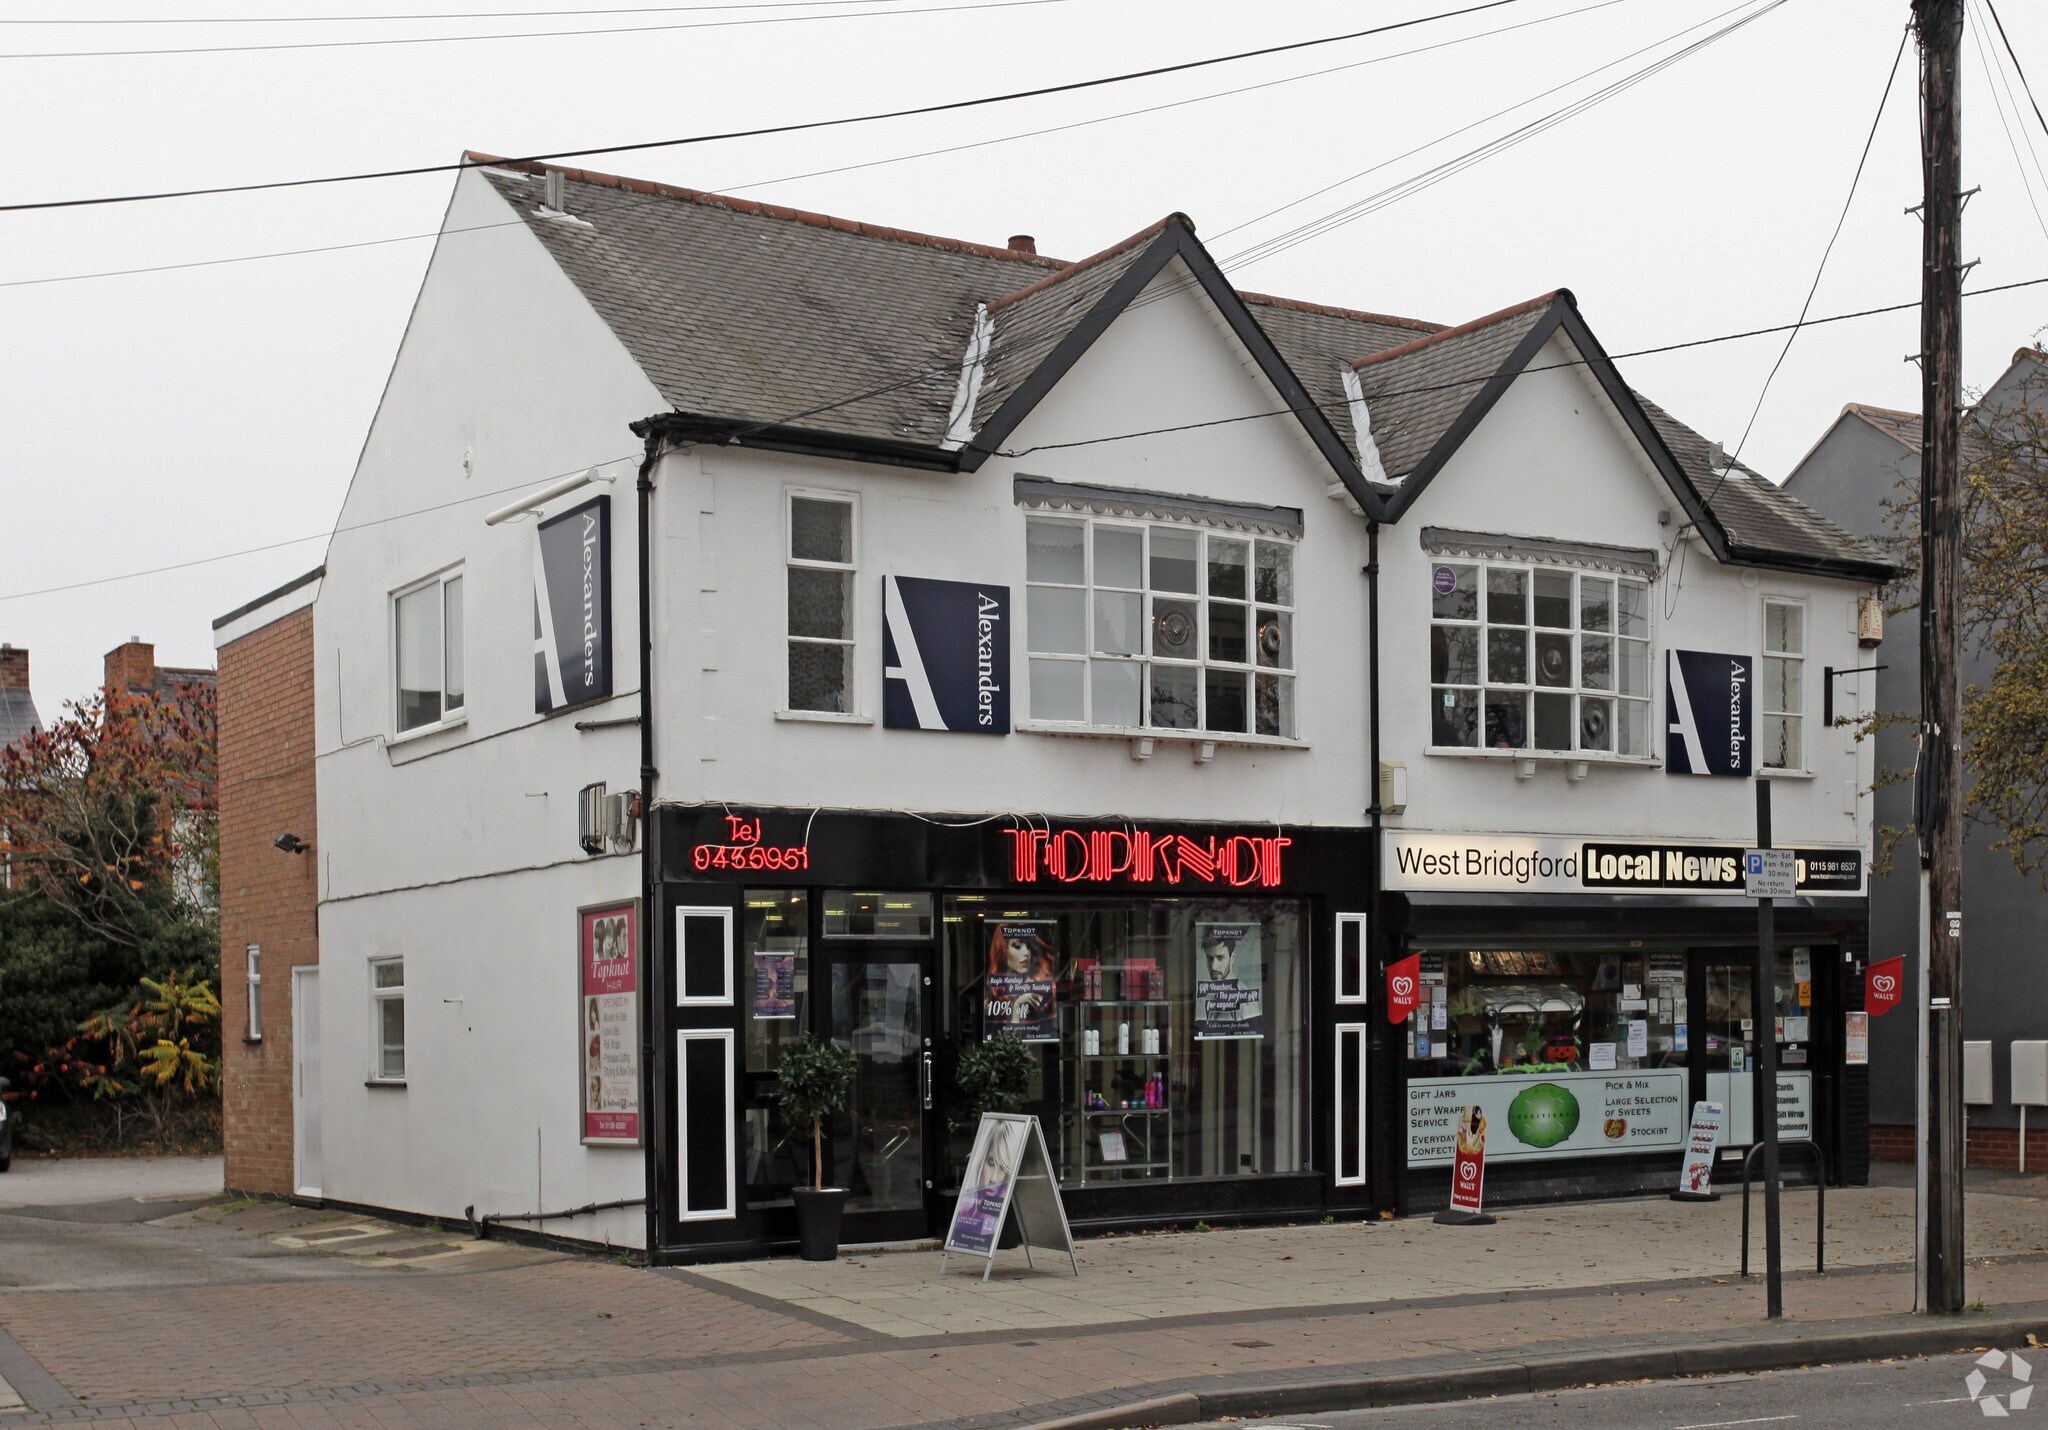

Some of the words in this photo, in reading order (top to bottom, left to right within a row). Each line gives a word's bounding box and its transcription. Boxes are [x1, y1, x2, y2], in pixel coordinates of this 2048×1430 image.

[583, 512, 598, 687] Alexanders
[978, 591, 1000, 726] Alexanders
[1730, 659, 1746, 769] Alexanders
[725, 816, 761, 842] Tel
[1003, 830, 1292, 887] TOPKNOT
[1396, 847, 1460, 875] West
[1465, 848, 1578, 884] Bridgford
[1587, 849, 1660, 880] Local
[1666, 851, 1737, 881] News
[1810, 861, 1826, 871] 0115
[1827, 861, 1839, 871] 981
[1840, 862, 1857, 871] 6537
[591, 959, 630, 983] Topknot
[1003, 977, 1023, 985] Mondays
[1032, 984, 1051, 993] Tuesdays
[1199, 983, 1209, 994] Gift
[1219, 991, 1228, 1000] The
[1228, 991, 1247, 1001] perfect
[1247, 991, 1258, 1001] gift
[1393, 996, 1412, 1005] WALL'S
[1874, 992, 1894, 1000] WALL'S
[987, 1000, 1012, 1017] 10%
[1016, 1003, 1030, 1019] off
[1207, 1001, 1216, 1011] for
[1216, 1001, 1238, 1011] anyone!
[1605, 1082, 1624, 1090] PICK
[1626, 1081, 1632, 1089] &
[1635, 1081, 1649, 1089] MIX
[1410, 1091, 1431, 1100] GIFT
[1434, 1090, 1456, 1099] JARS
[1605, 1098, 1631, 1106] LARGE
[1634, 1096, 1678, 1105] SELECTION
[1410, 1107, 1431, 1116] GIFT
[1434, 1106, 1466, 1115] WRAPP
[1618, 1108, 1651, 1116] SWEETS
[1411, 1119, 1448, 1128] SERVICE
[1777, 1123, 1808, 1132] Stationery
[1631, 1127, 1668, 1136] STOCKIST
[1412, 1134, 1456, 1144] EVERYDAY
[1411, 1146, 1455, 1156] CONFECTI
[1459, 1181, 1475, 1190] WALL'S
